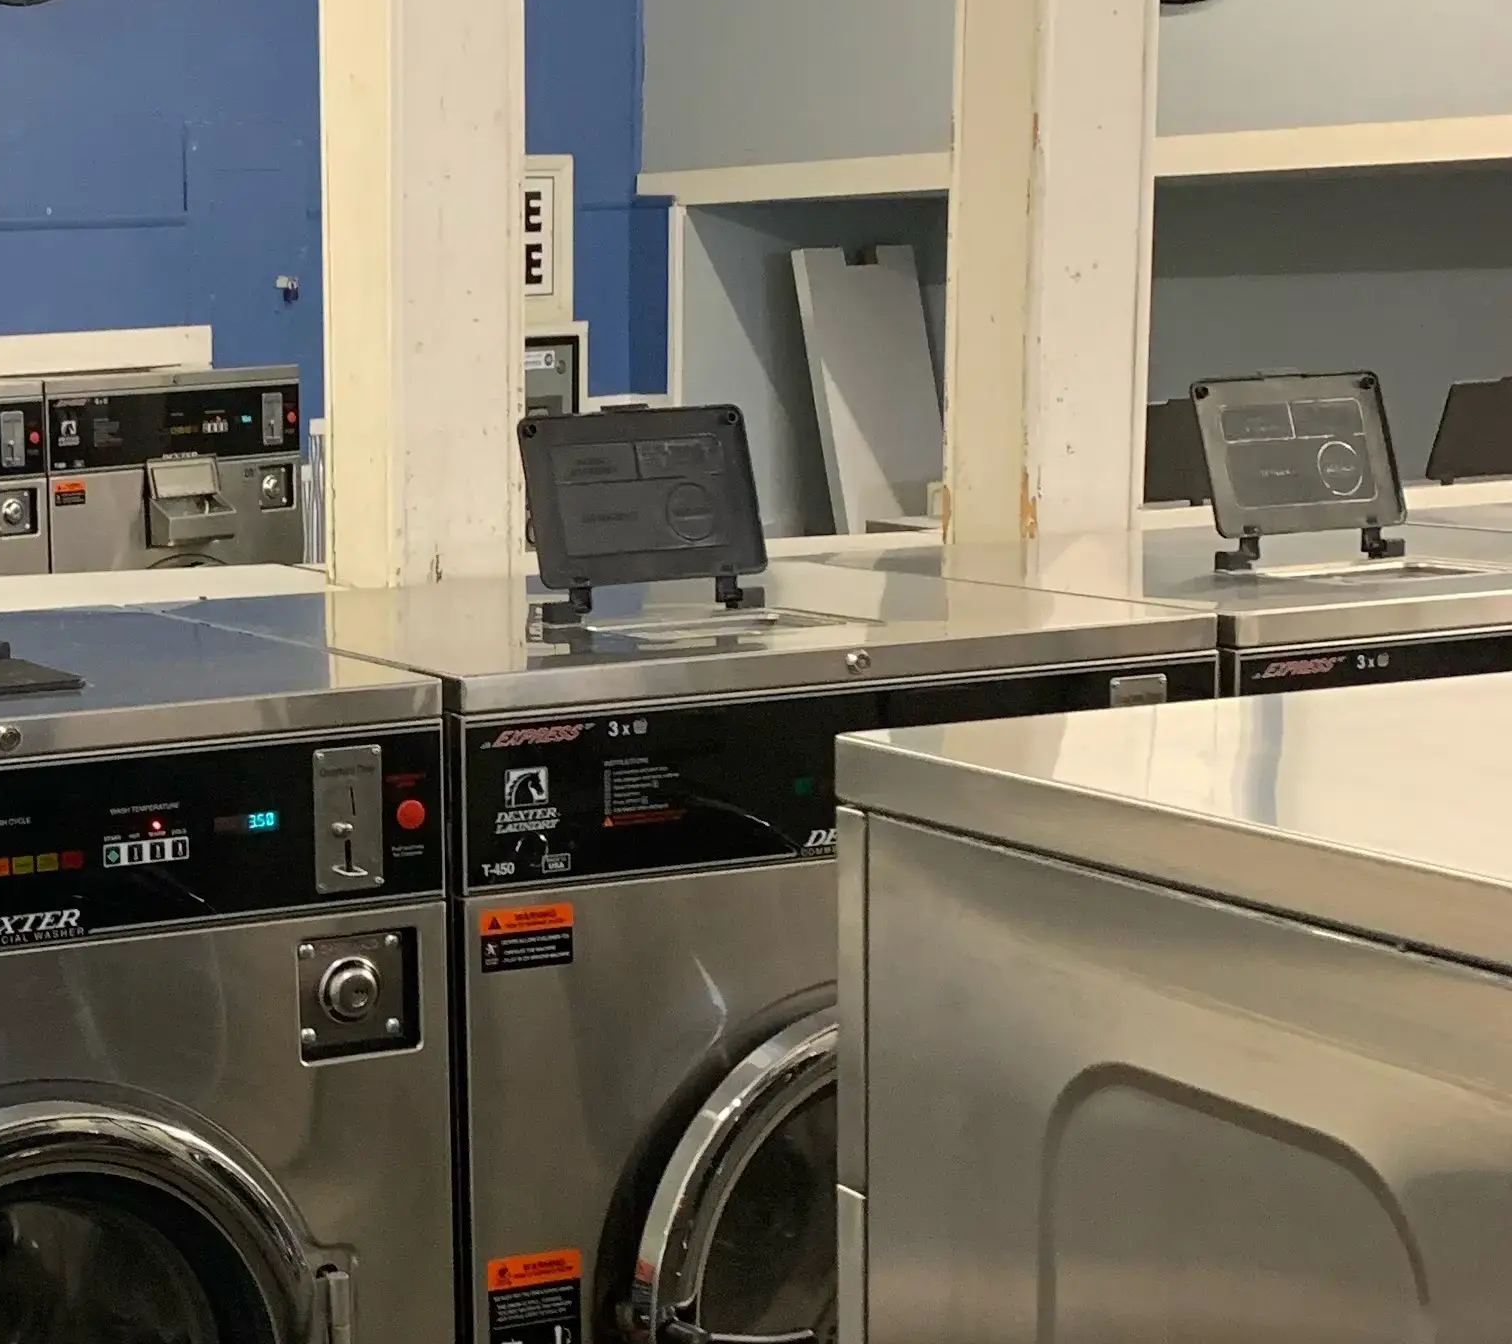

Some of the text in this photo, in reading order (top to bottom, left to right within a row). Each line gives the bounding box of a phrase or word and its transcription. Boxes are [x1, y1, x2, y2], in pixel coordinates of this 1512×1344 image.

[1356, 654, 1366, 669] 3
[492, 723, 584, 748] EXPRESS
[608, 721, 630, 737] 3 x
[495, 807, 557, 824] DEXTER
[481, 861, 516, 877] T-450
[35, 926, 85, 941] WASHER
